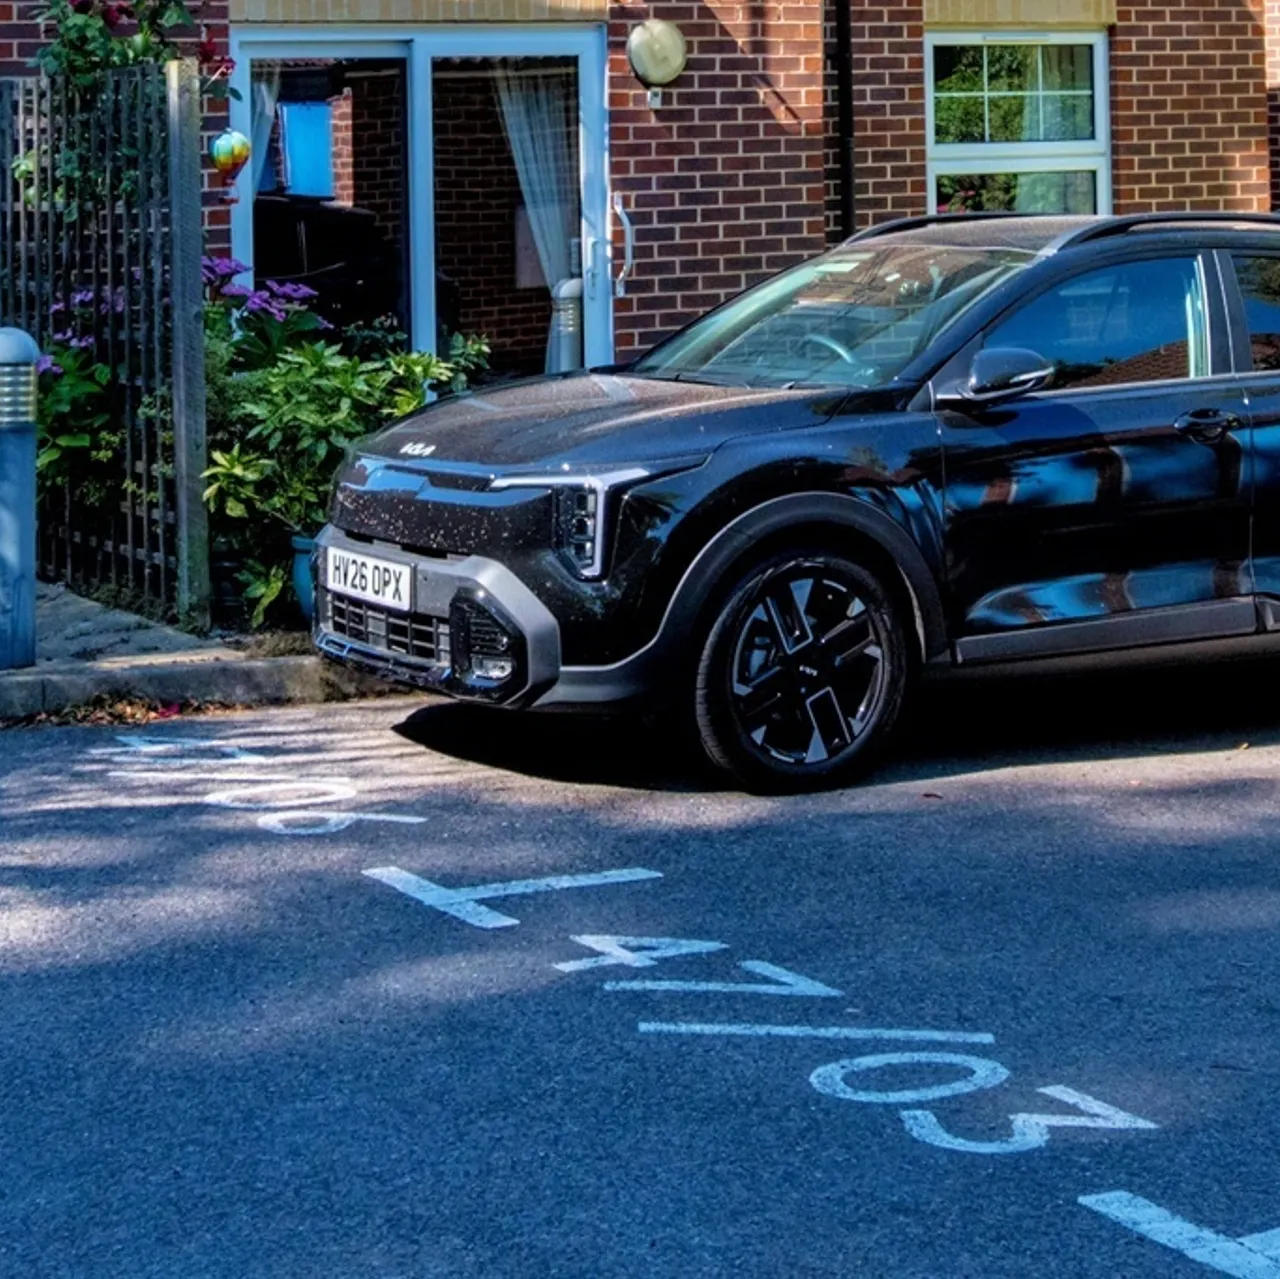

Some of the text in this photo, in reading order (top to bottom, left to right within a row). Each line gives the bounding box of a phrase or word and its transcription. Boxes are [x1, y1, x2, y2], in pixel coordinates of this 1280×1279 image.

[400, 441, 436, 457] KIA
[333, 553, 402, 602] HV26 OPX
